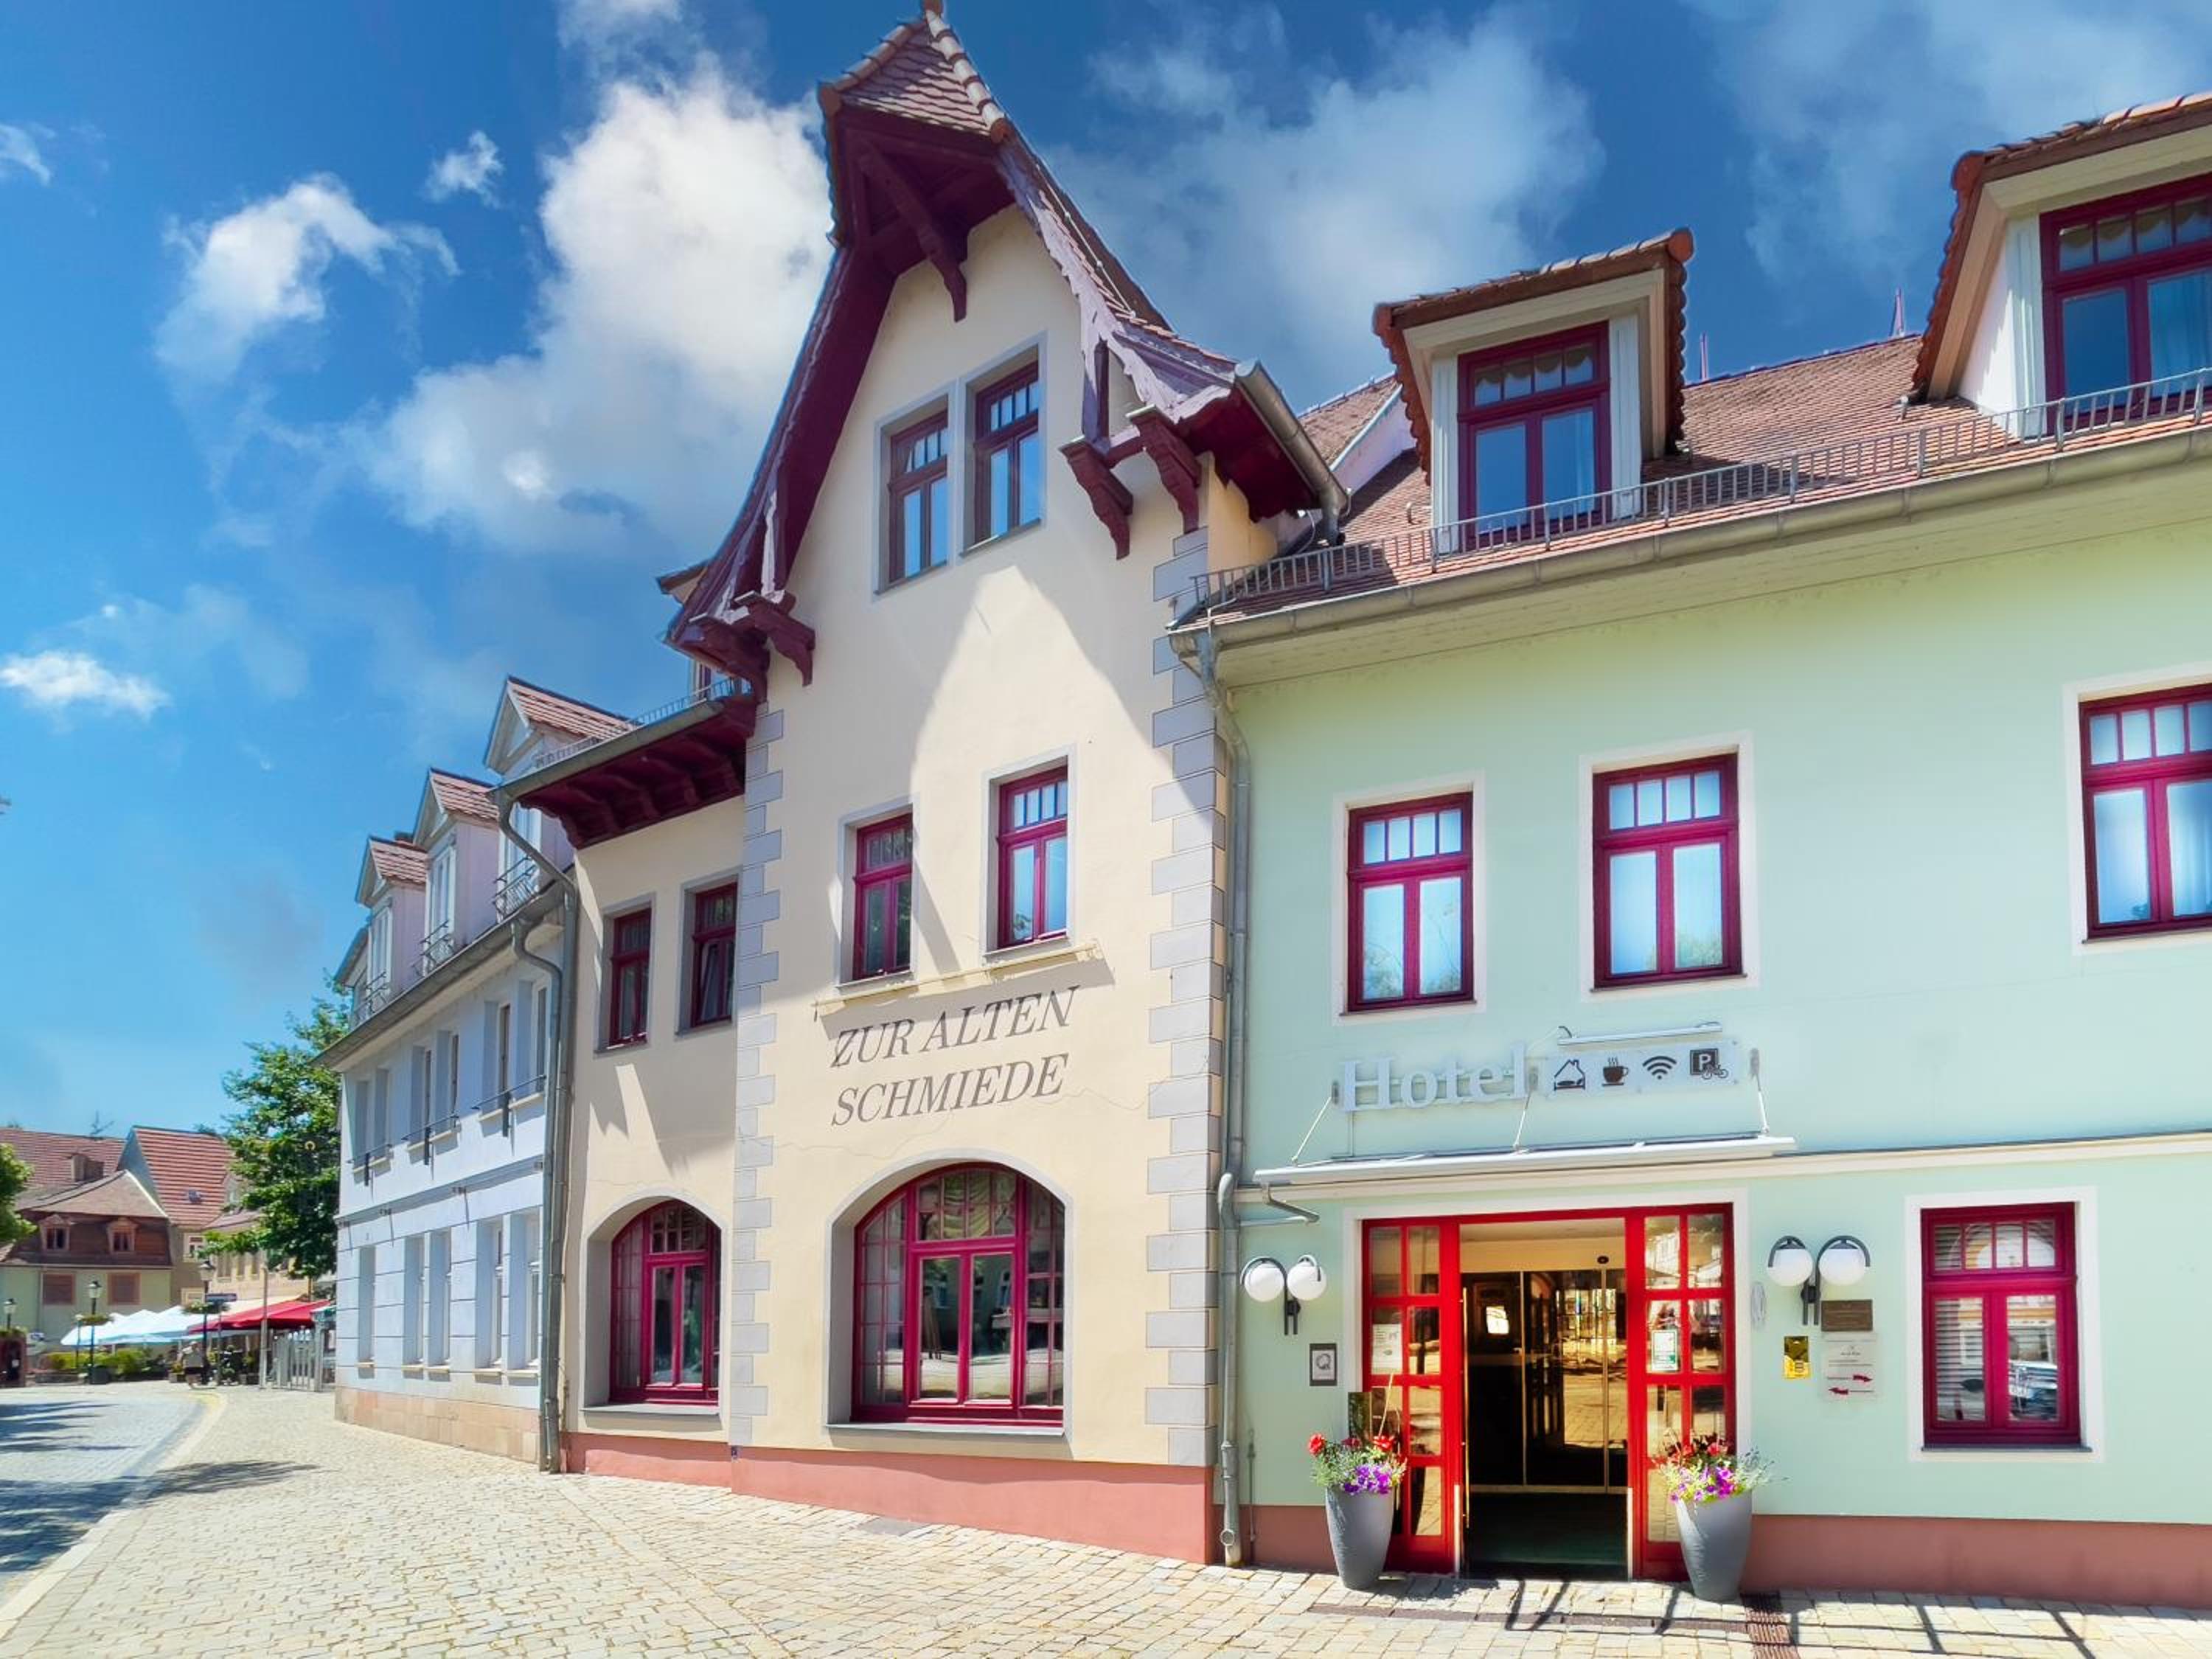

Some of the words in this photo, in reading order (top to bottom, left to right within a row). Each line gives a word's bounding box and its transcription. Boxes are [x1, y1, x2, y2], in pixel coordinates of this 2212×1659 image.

[830, 1018, 915, 1068] ZUR
[919, 985, 1081, 1053] ALTEN
[1698, 1053, 1711, 1071] P
[831, 1053, 1069, 1127] SCHMIEDE
[1340, 1041, 1529, 1113] Hotel
